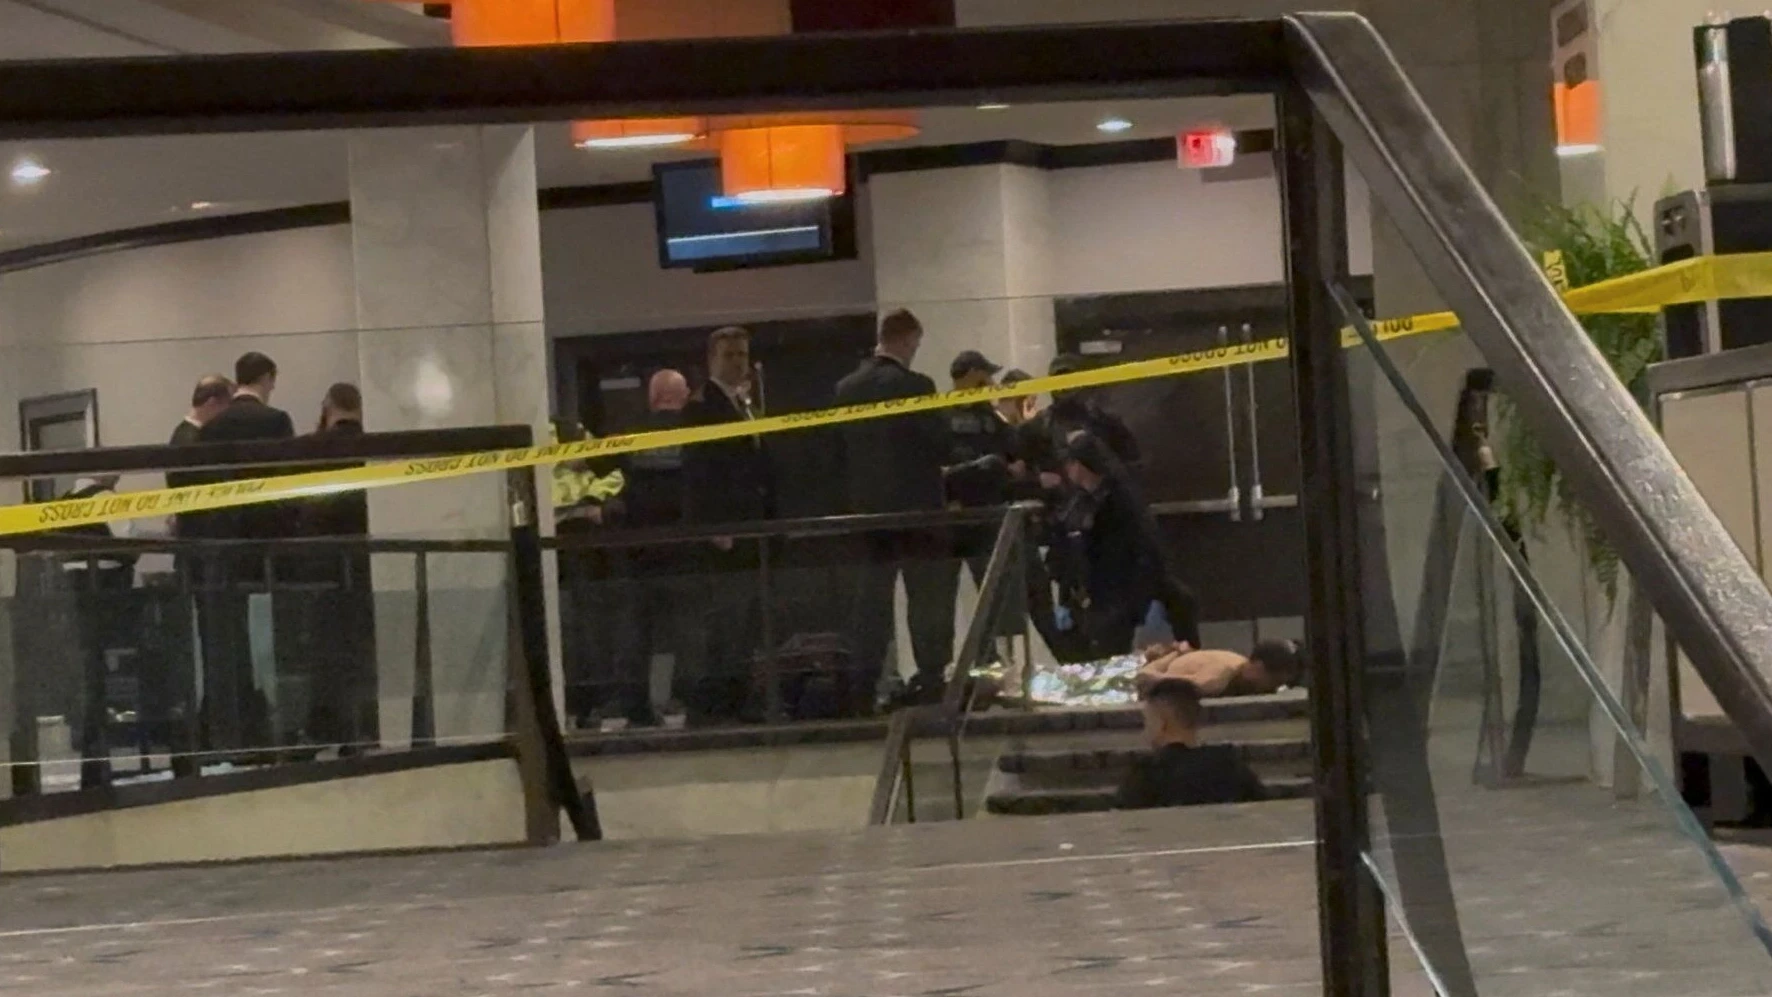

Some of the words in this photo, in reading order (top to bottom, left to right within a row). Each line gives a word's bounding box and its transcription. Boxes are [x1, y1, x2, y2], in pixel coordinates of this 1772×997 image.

[42, 501, 96, 522] CROSS
[99, 499, 132, 515] NOT
[137, 494, 161, 512] DO
